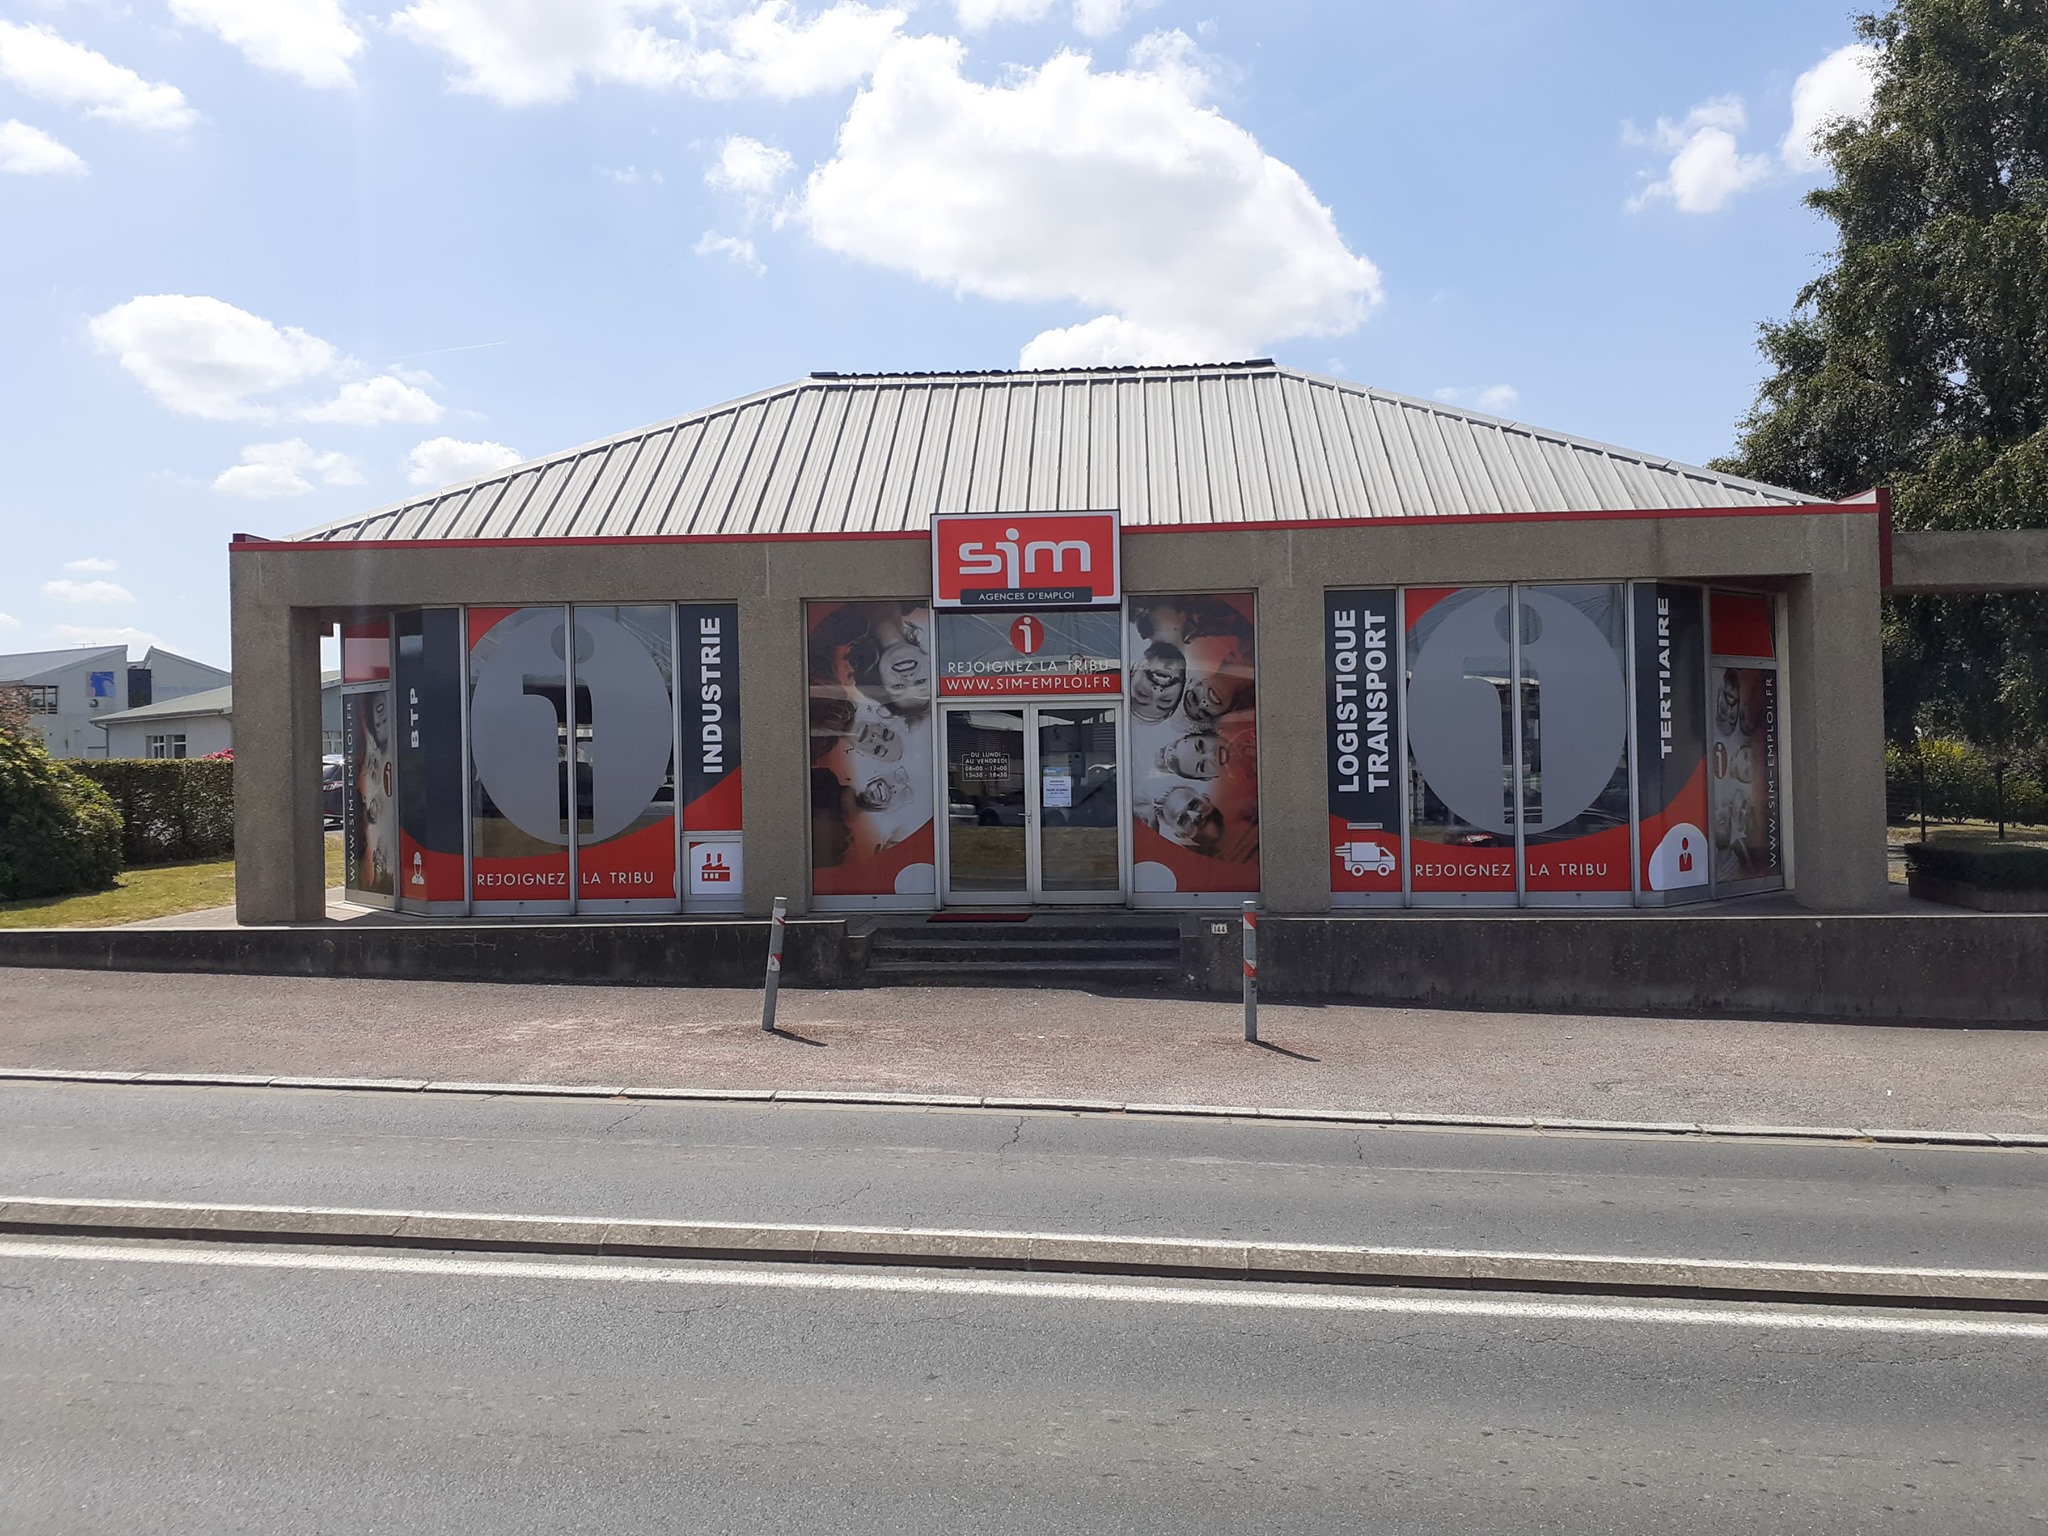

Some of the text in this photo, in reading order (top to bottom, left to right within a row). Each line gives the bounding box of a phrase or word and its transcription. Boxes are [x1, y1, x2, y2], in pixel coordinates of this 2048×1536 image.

[959, 528, 1091, 588] sim
[979, 592, 1075, 601] AGENCES D'EMPLOI
[700, 617, 723, 773] INDUSTRIE
[946, 676, 1111, 690] WWW.SIM-EMPLOI.FR
[948, 659, 1109, 673] REJOIGNEZ LA TRIBU
[1657, 597, 1672, 759] TERTIAIRE
[409, 687, 420, 748] BTP
[1334, 610, 1360, 792] LOGISTIQUE
[1364, 610, 1390, 793] TRANSPORT
[1765, 677, 1777, 868] WWW.SIM-EMPLOI.FR
[477, 872, 654, 886] REJOIGNEZ LA TRIBU
[1415, 863, 1608, 877] REJOIGNEZ LA TRIBU
